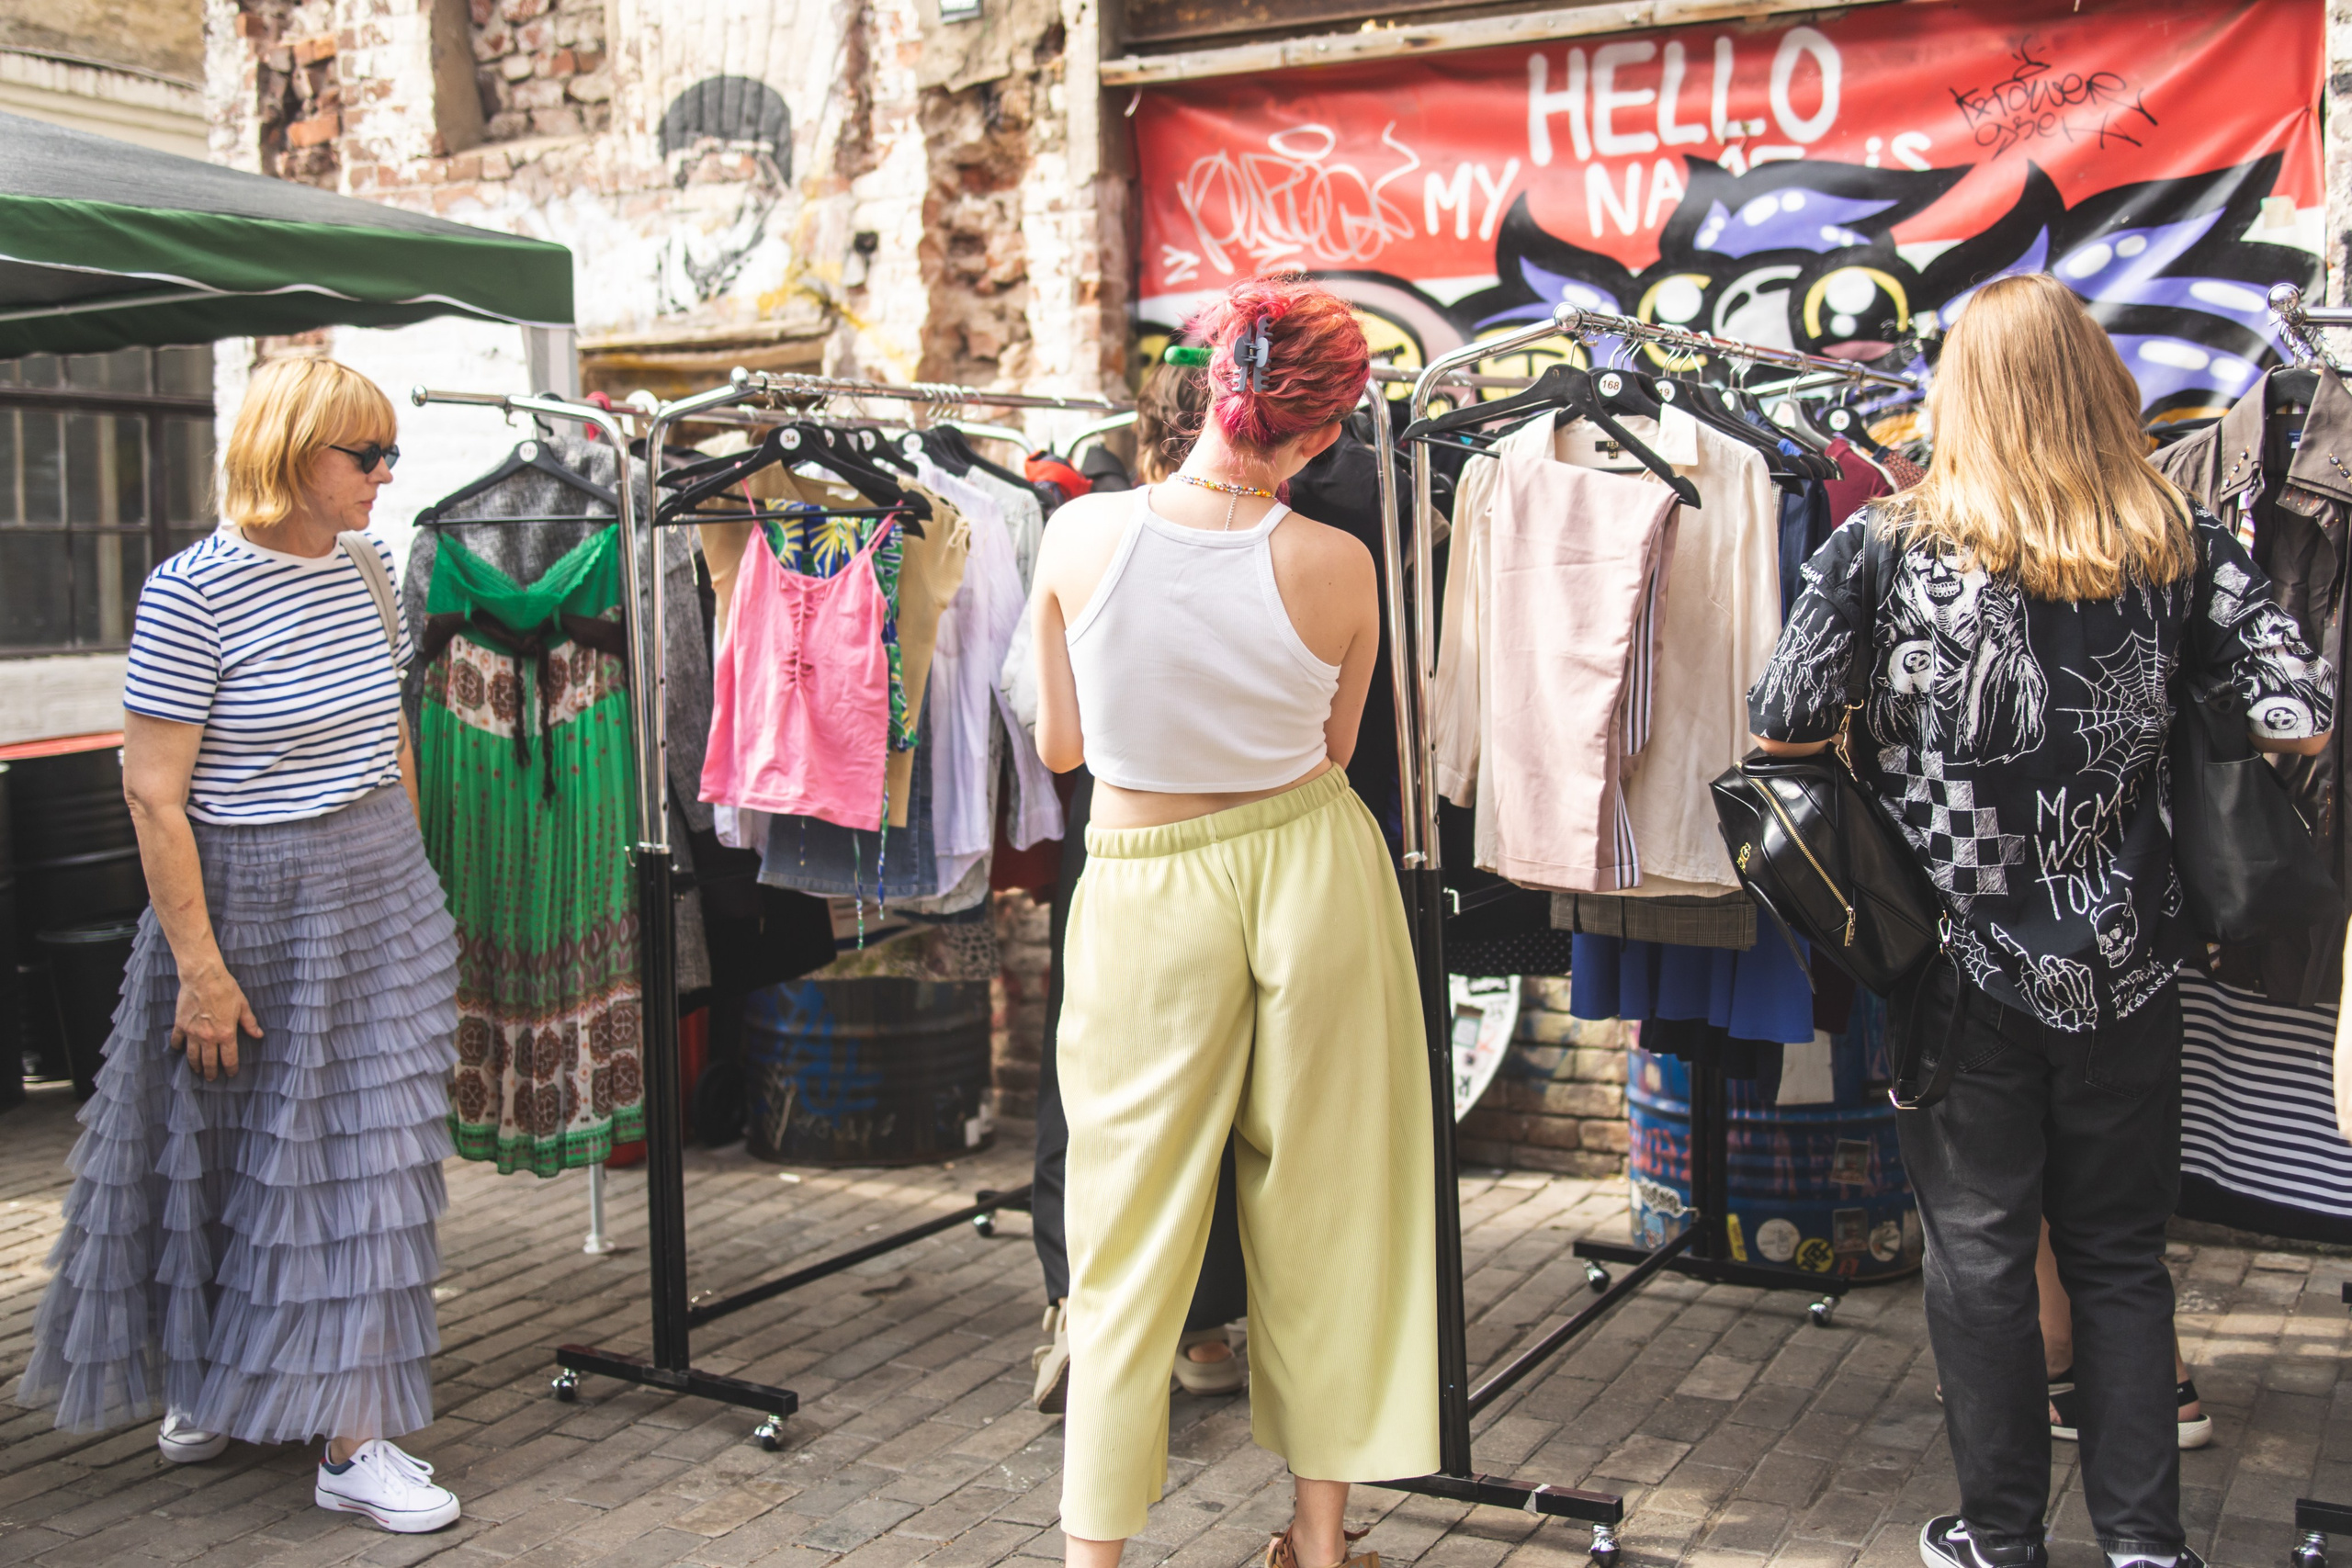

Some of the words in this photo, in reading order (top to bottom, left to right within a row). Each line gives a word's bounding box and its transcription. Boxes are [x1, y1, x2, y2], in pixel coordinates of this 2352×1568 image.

[1527, 26, 1842, 167] HELLO
[1423, 158, 1521, 241] MY
[1601, 378, 1620, 390] 168
[785, 434, 796, 443] 34
